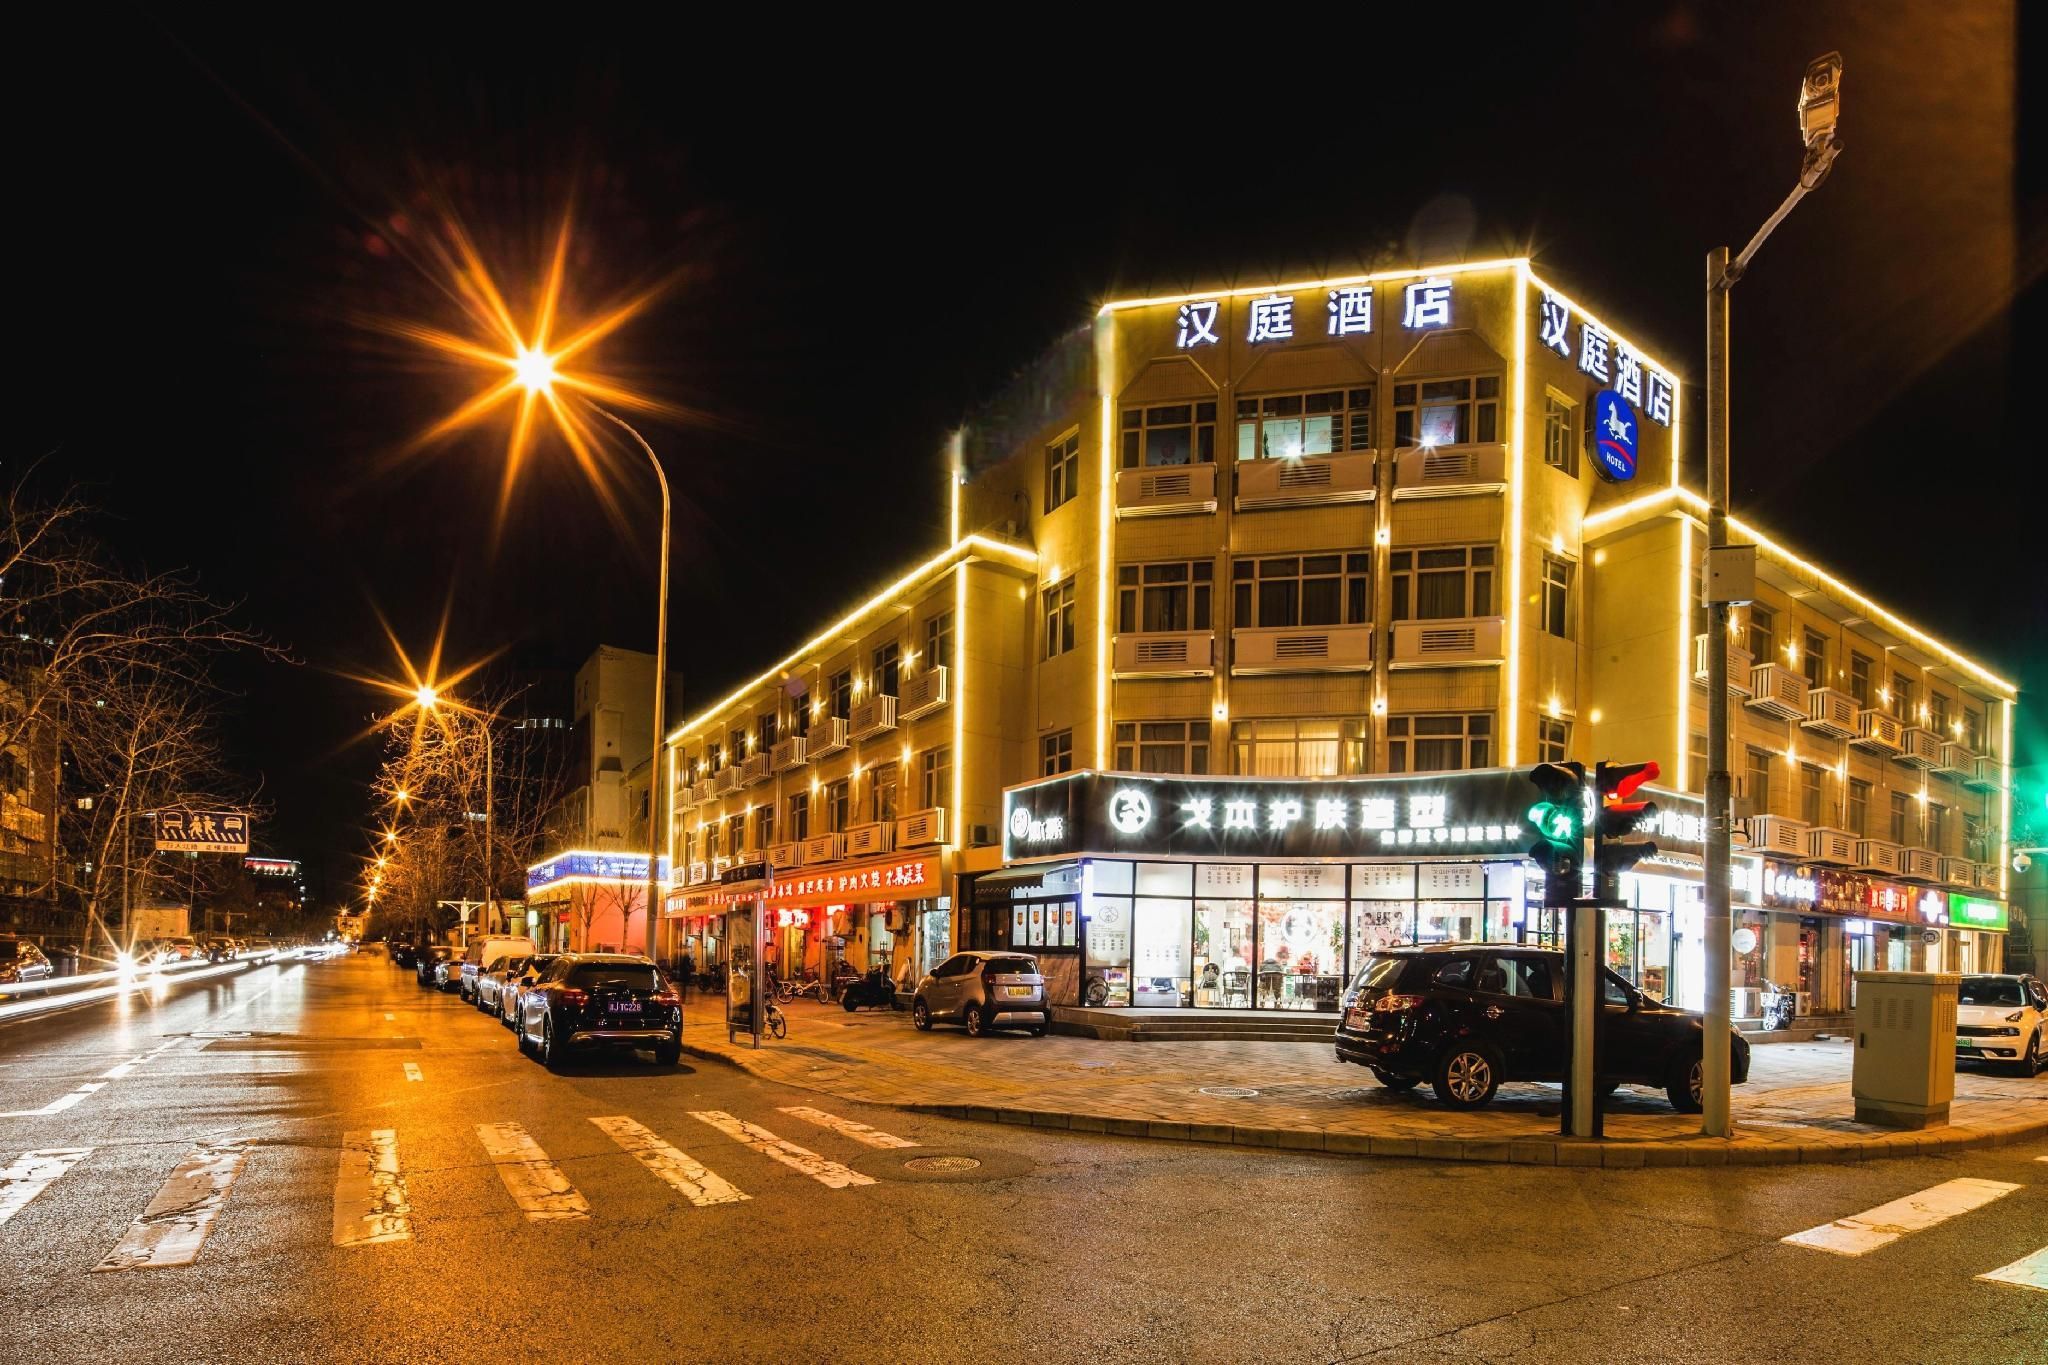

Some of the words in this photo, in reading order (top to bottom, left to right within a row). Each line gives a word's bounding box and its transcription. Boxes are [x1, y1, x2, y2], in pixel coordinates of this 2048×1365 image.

[1178, 277, 1453, 348] 汉庭酒店
[1540, 292, 1675, 427] 汉庭酒店
[1606, 451, 1626, 472] HOTEL
